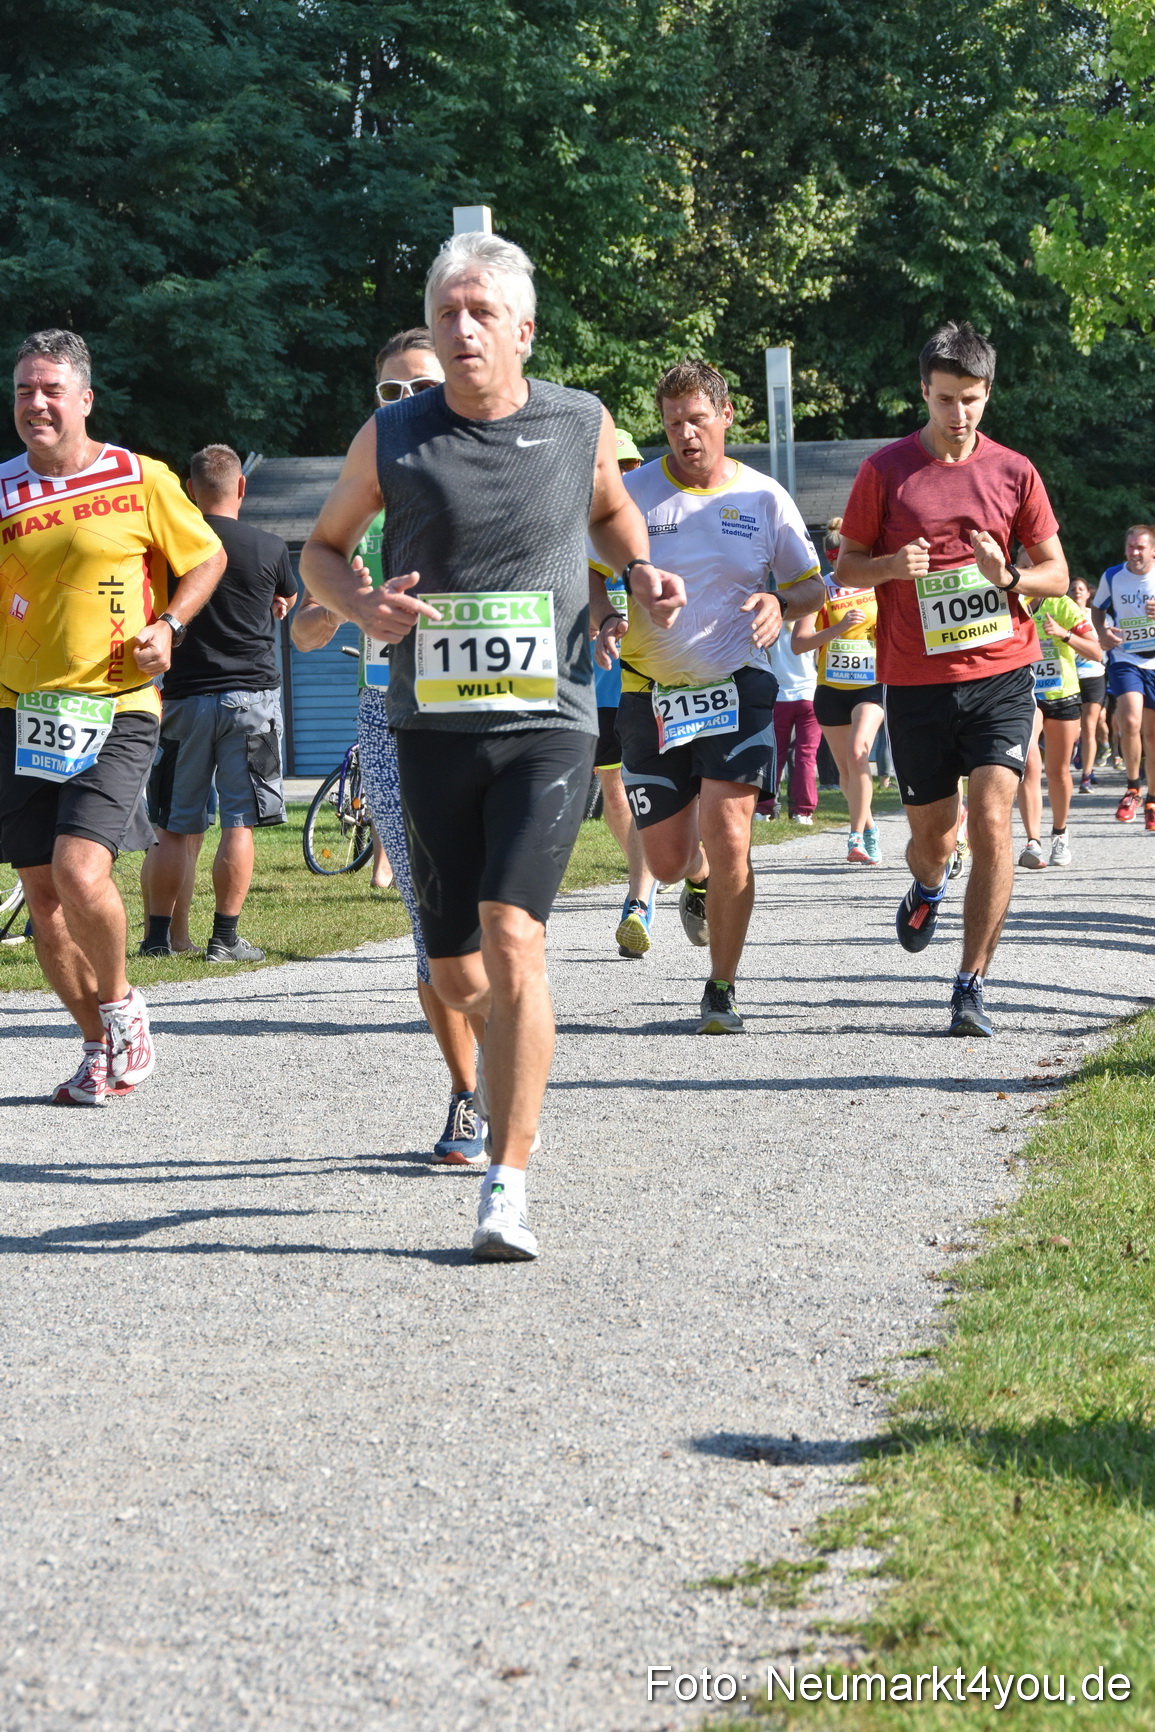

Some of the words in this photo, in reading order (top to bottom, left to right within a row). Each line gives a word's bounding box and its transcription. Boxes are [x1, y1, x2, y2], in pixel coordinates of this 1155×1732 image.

[2, 510, 64, 544] MAX
[73, 494, 144, 520] BÖGL
[722, 508, 739, 520] 20
[648, 523, 678, 533] BOCK
[721, 521, 760, 532] Neumarkter
[721, 528, 752, 539] Stadtlauf
[429, 600, 537, 624] BOCK
[831, 601, 853, 611] MAX
[931, 589, 999, 624] 1090
[941, 622, 998, 643] FLORIAN
[433, 636, 537, 672] 1197
[831, 655, 868, 669] 2381
[457, 680, 513, 697] WILLI
[25, 691, 103, 720] BOCK
[658, 689, 728, 722] 2158
[27, 717, 97, 753] 2397
[664, 714, 730, 741] BERNHARD
[31, 754, 84, 773] DIETMAR
[628, 787, 652, 817] 15
